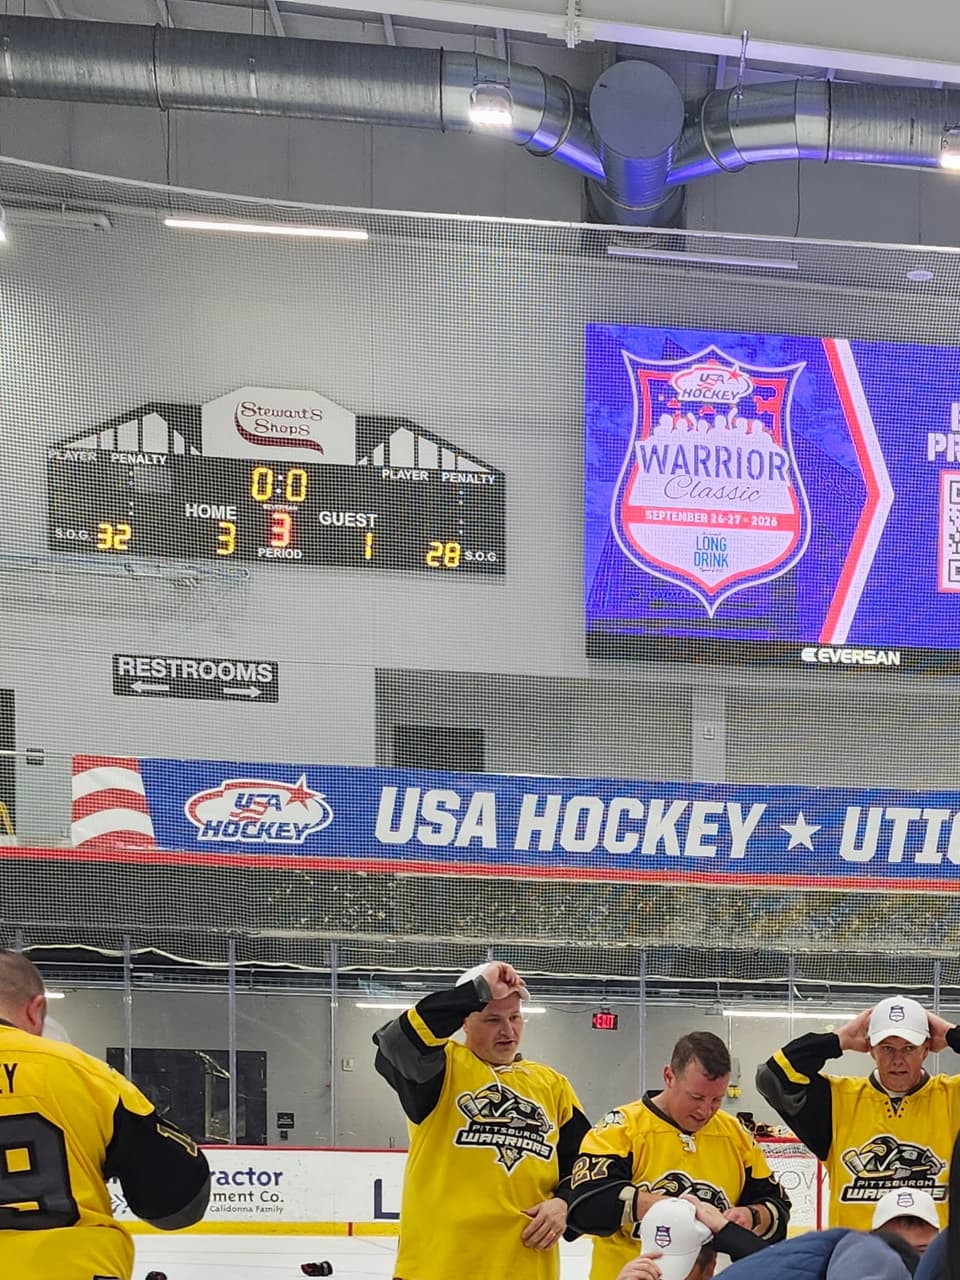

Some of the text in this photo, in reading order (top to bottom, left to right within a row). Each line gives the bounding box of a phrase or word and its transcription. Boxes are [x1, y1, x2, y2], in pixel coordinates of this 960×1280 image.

[681, 387, 740, 401] HOCKEY
[111, 452, 168, 465] PENALTY
[639, 443, 787, 482] WARRIOR
[381, 469, 496, 486] PLAYER PENALTY
[664, 475, 762, 502] Classic
[184, 503, 238, 520] HOME
[318, 510, 378, 528] GUEST
[645, 510, 709, 523] SEPTEMBER
[710, 513, 741, 525] 26-27
[96, 522, 133, 551] 32
[217, 521, 238, 556] 3
[269, 512, 292, 548] 3
[257, 547, 302, 559] PERIOD
[363, 532, 375, 561] 1
[696, 536, 728, 552] LONG
[425, 541, 462, 568] 28
[694, 551, 729, 568] DRINK
[818, 648, 900, 666] EVERSAN
[118, 656, 273, 683] RESTROOMS
[234, 792, 282, 812] USA
[201, 819, 310, 840] HOCKEY
[375, 785, 498, 852] USA
[514, 793, 768, 862] HOCKEY
[471, 1124, 545, 1144] PITTSBURGH
[460, 1131, 552, 1158] WARRIORS
[571, 1155, 615, 1190] 27
[856, 1179, 934, 1188] PITTSBURGH
[213, 1190, 285, 1204] ment Co.
[256, 1205, 284, 1215] Family
